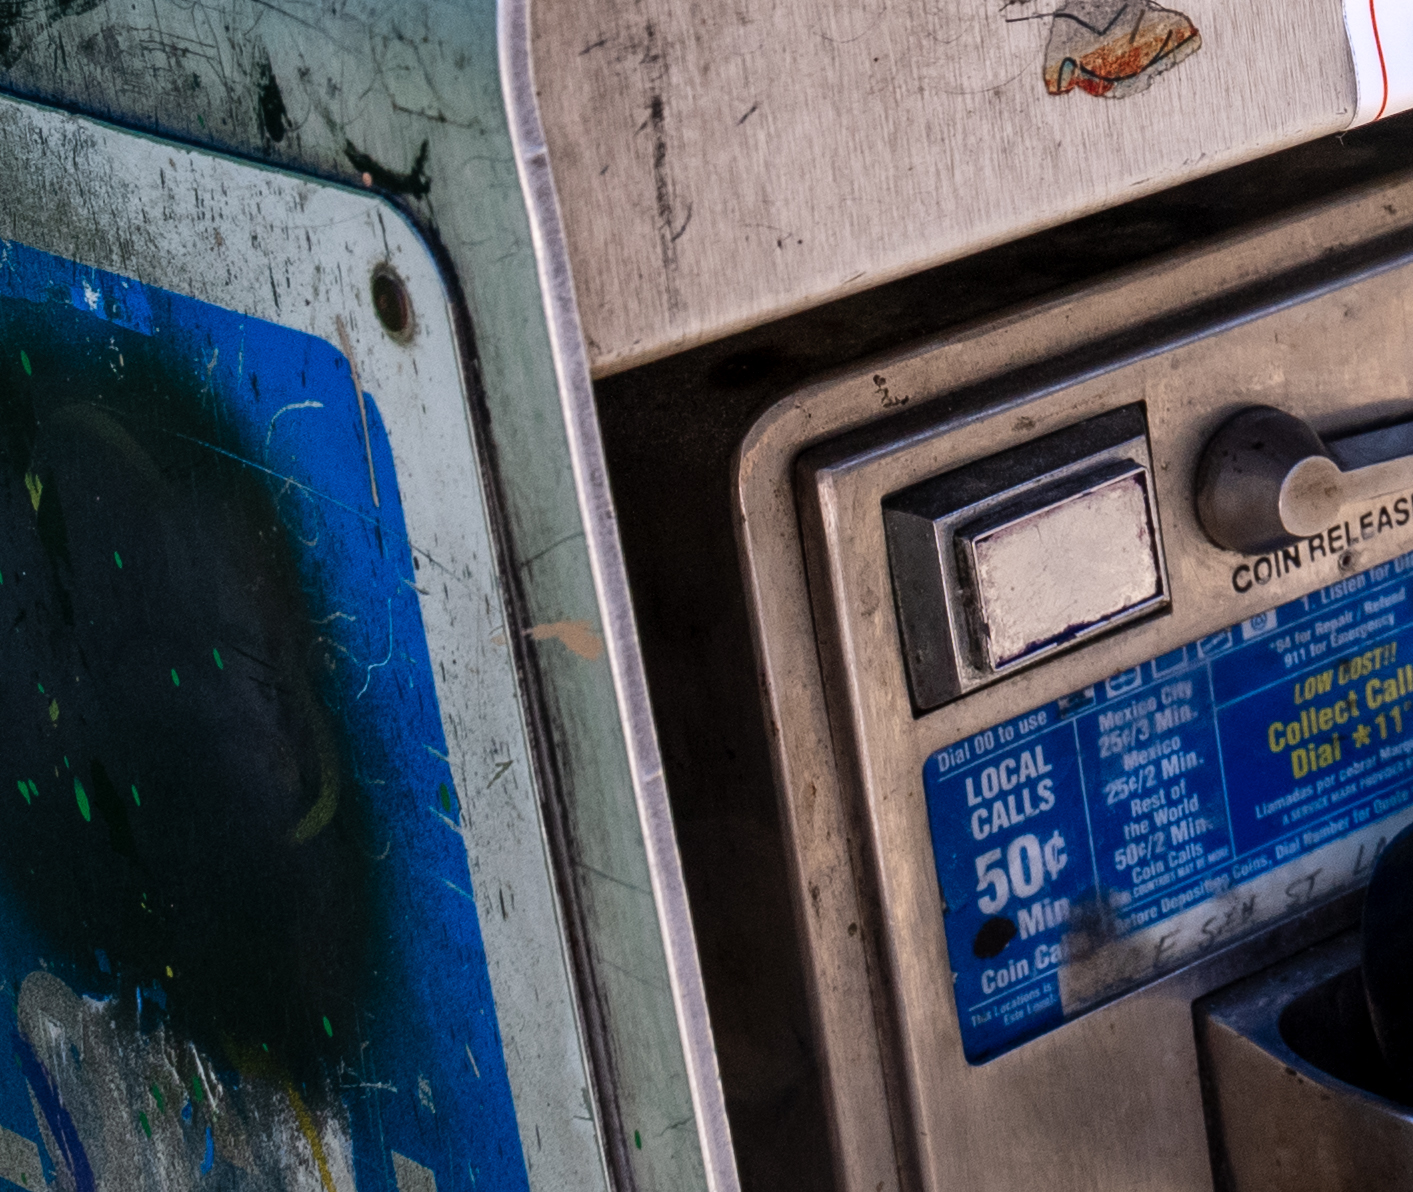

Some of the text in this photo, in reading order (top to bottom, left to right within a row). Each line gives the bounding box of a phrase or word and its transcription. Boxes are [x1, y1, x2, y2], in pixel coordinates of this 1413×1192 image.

[1231, 542, 1303, 595] COIN
[1320, 573, 1366, 605] Listen
[1369, 564, 1390, 583] for
[1283, 612, 1395, 668] 911 for Emergency
[1294, 629, 1312, 645] for
[1315, 610, 1354, 636] Repair
[1363, 585, 1406, 615] Refund
[1294, 641, 1398, 705] LOW COST!!
[1098, 679, 1194, 733] Mexico City
[1098, 704, 1199, 759] 25¢/3 Min.
[1268, 689, 1360, 753] Collect
[937, 710, 1048, 773] Dial 00 to use
[1121, 735, 1181, 772] Mexico
[1291, 732, 1341, 780] Dial
[965, 744, 1053, 807] LOCAL
[1102, 750, 1204, 806] 25¢/2 Min.
[1131, 777, 1186, 818] Rest of
[1255, 785, 1314, 820] Llamadas
[1316, 774, 1336, 795] por
[1338, 757, 1377, 782] cobrar
[1290, 796, 1329, 821] SERVICE
[1330, 783, 1358, 803] MARK
[970, 778, 1056, 841] CALLS
[1123, 793, 1199, 840] the World
[1232, 854, 1272, 879] Coins,
[1275, 837, 1300, 860] Dial
[1302, 817, 1350, 847] Number
[1352, 807, 1371, 824] for
[1372, 789, 1410, 815] Quote
[1114, 816, 1214, 871] 50¢/2 Min.
[1131, 843, 1203, 884] Coin Calls
[974, 829, 1069, 916] 50¢
[1016, 897, 1071, 941] Min
[980, 959, 1030, 995] Coin
